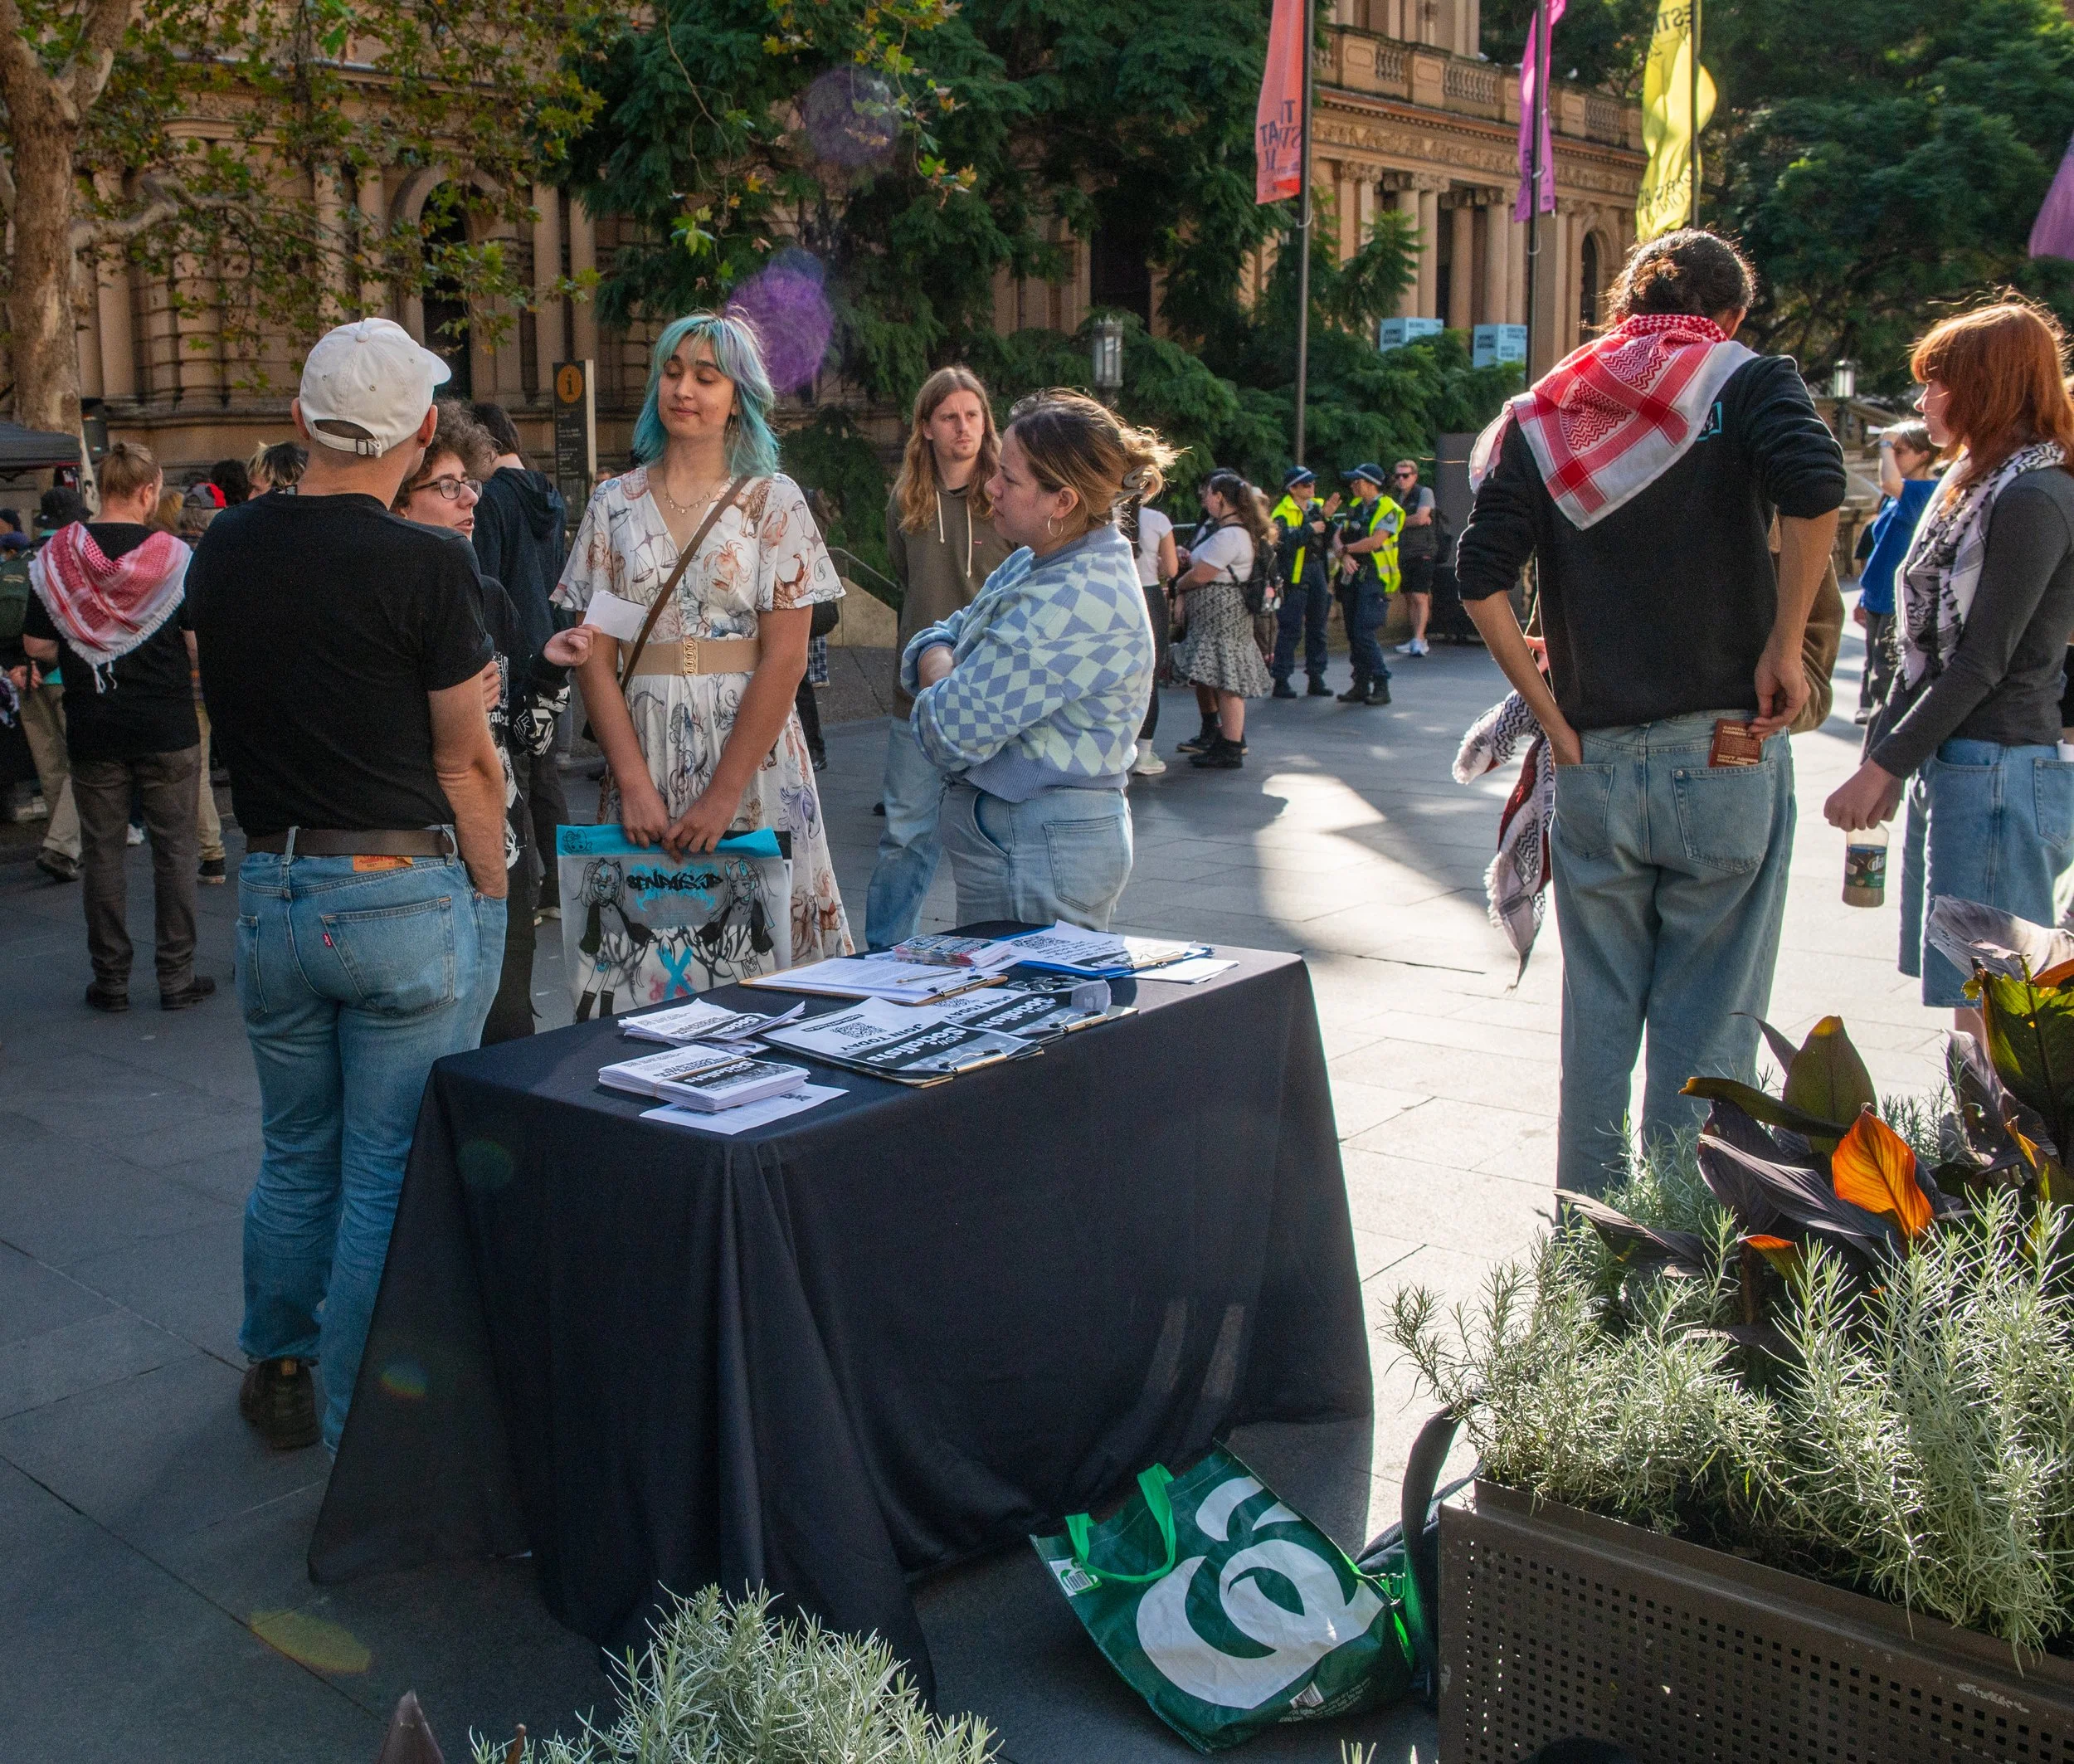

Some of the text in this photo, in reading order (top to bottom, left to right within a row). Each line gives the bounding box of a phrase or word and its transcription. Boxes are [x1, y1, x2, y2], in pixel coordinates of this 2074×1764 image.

[943, 1005, 987, 1020] TODAY
[976, 997, 1057, 1028] Socialists
[840, 1023, 923, 1051] JOIN TODAY
[866, 1026, 967, 1062] Socialists
[937, 1033, 964, 1047] NSW
[684, 1060, 756, 1083] Socialists
